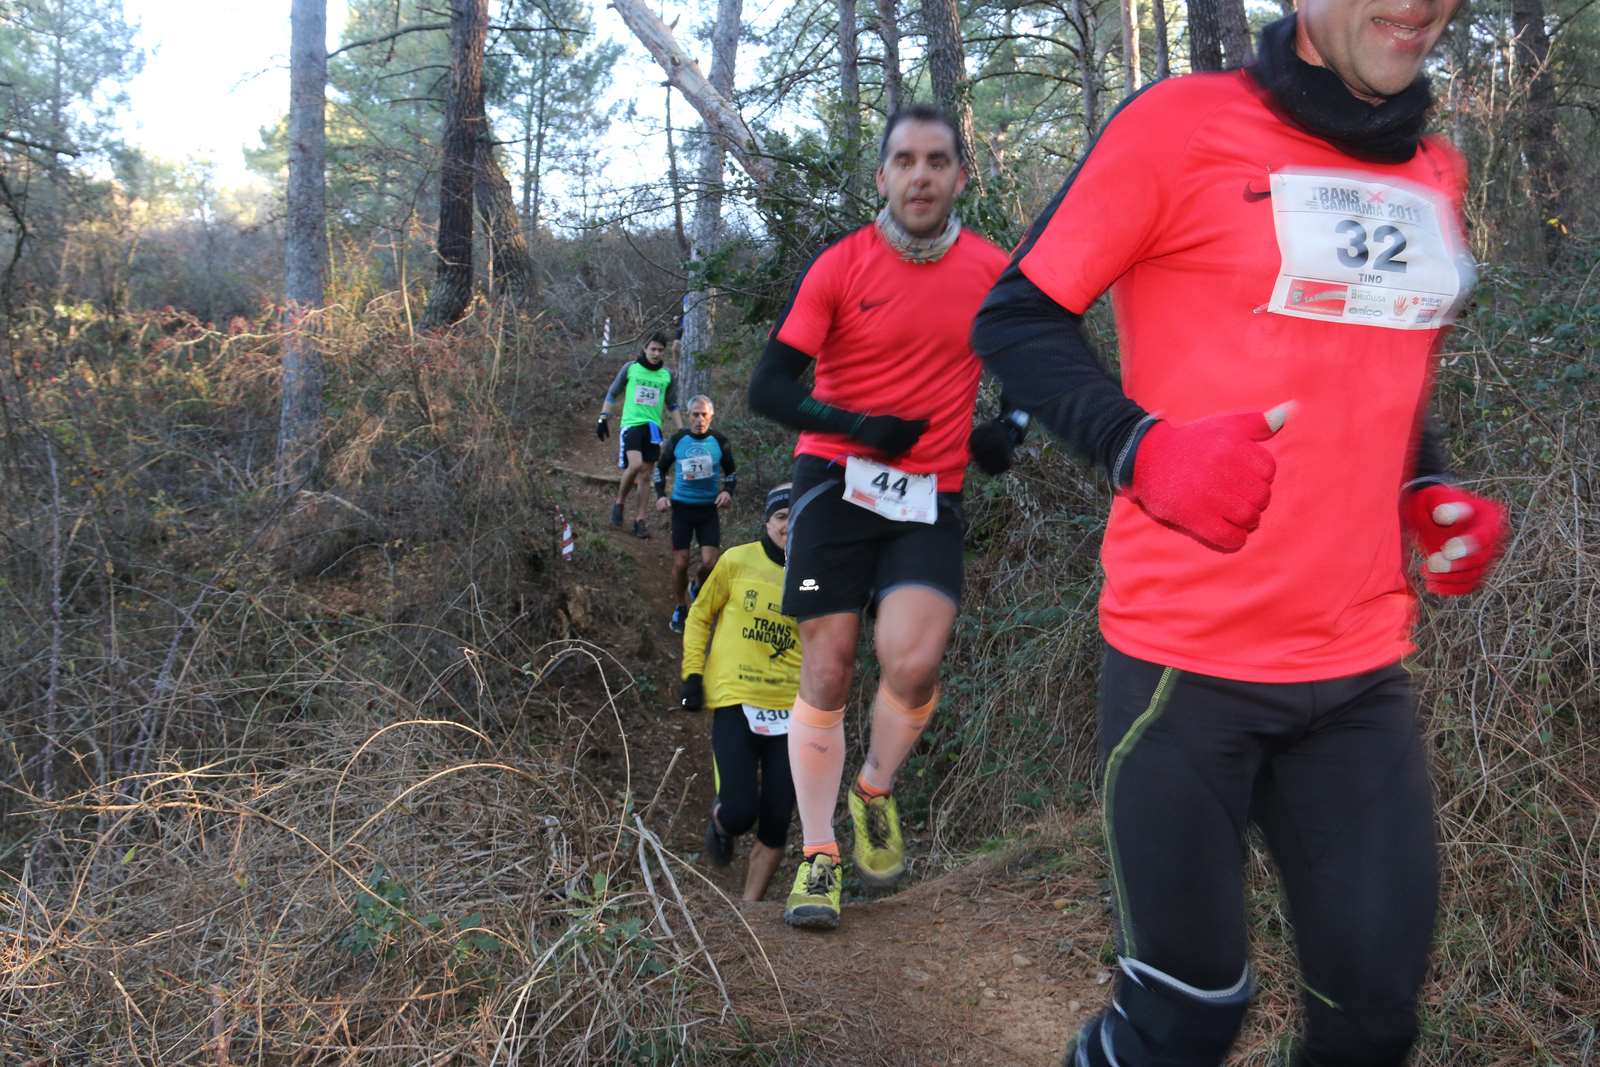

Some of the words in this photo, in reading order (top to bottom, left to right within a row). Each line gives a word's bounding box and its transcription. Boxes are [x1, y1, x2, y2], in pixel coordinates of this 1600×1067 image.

[1310, 187, 1360, 204] TRANS
[1335, 219, 1408, 274] 32
[1358, 273, 1384, 285] TINO
[871, 471, 909, 499] 44
[753, 616, 792, 638] TRANS
[742, 626, 797, 651] CANDAMIA
[755, 709, 790, 723] 430
